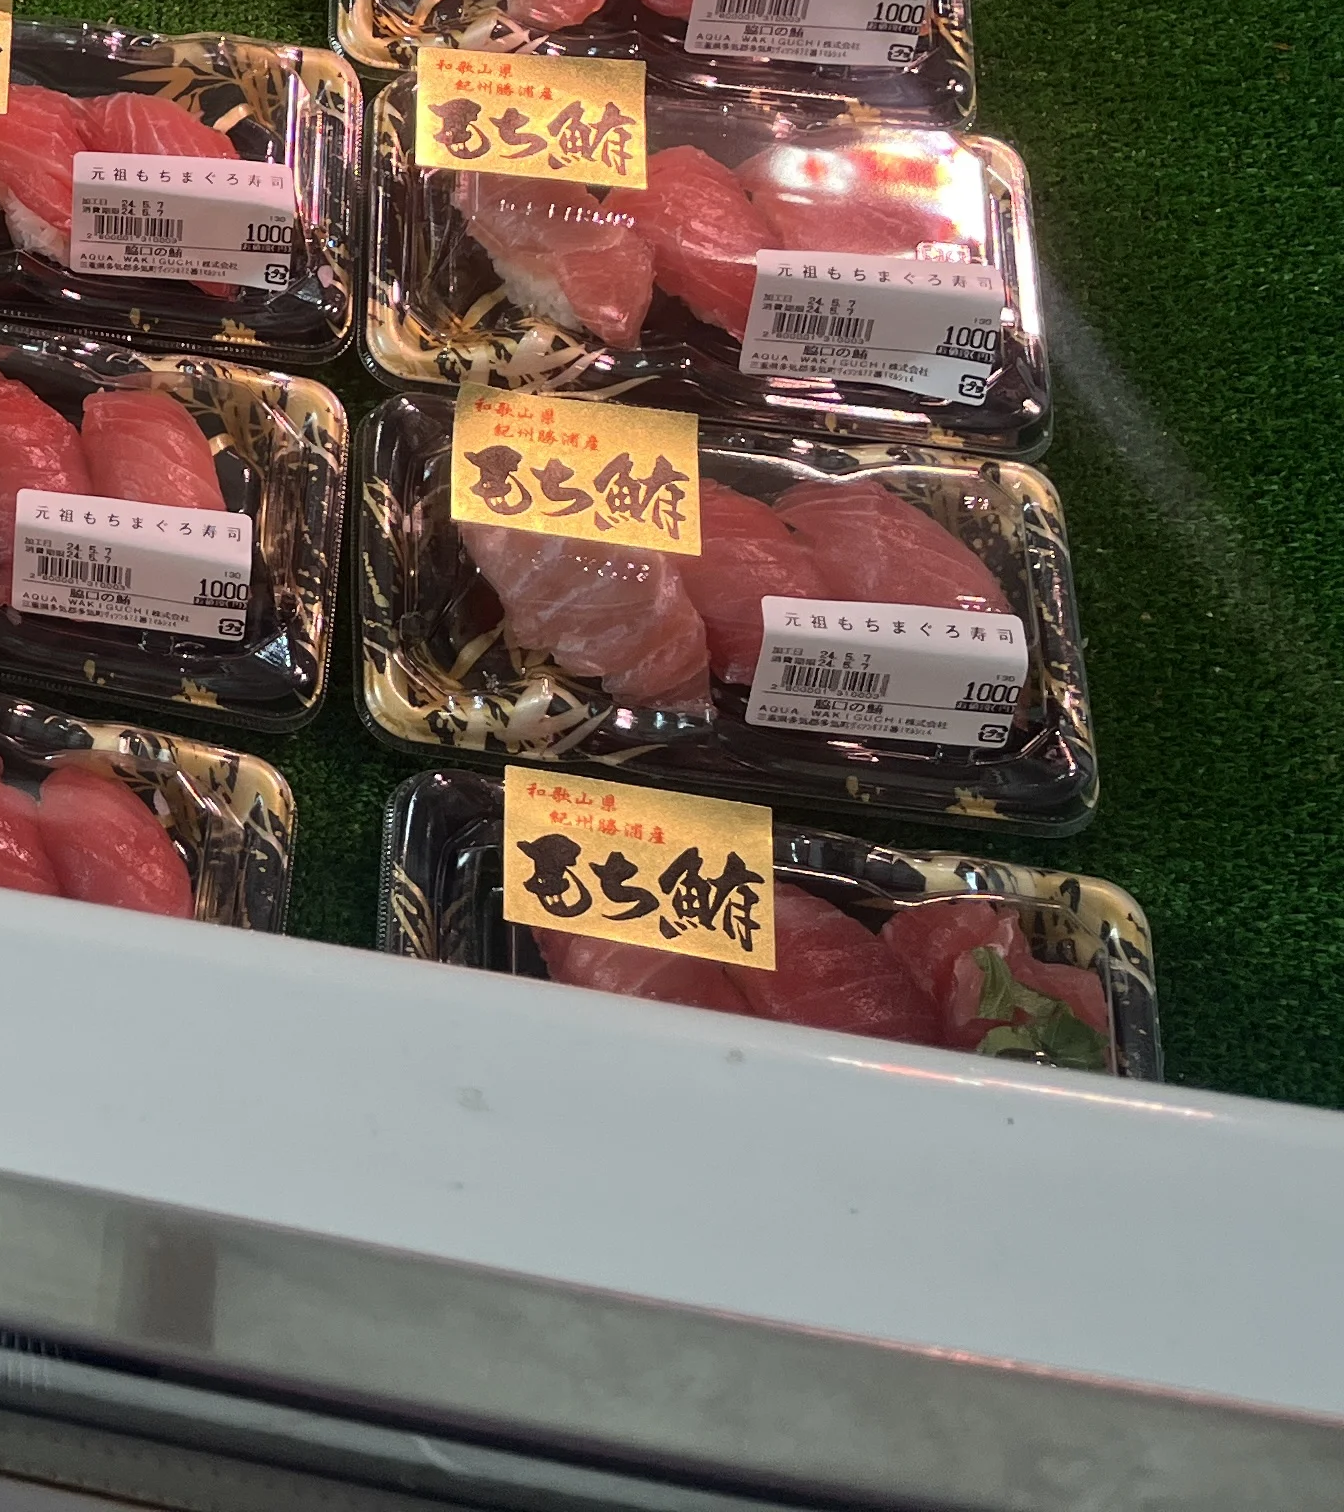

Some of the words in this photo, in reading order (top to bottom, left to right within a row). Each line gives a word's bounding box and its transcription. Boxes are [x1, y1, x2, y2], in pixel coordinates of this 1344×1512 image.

[872, 2, 925, 24] 1000
[436, 58, 513, 78] 和歌山県
[90, 162, 284, 196] 元祖もちまぐろ寿司
[245, 222, 292, 245] 1000
[777, 261, 994, 295] 元祖もちまぐろ寿司
[942, 324, 994, 351] 1000
[474, 397, 555, 423] 和歌山県
[35, 504, 242, 542] 元祖もちまぐろ寿司
[198, 578, 249, 602] 1000
[784, 610, 1016, 645] 元祖もちまぐろ寿司
[962, 681, 1018, 704] 1000
[527, 780, 616, 811] 和歌山県
